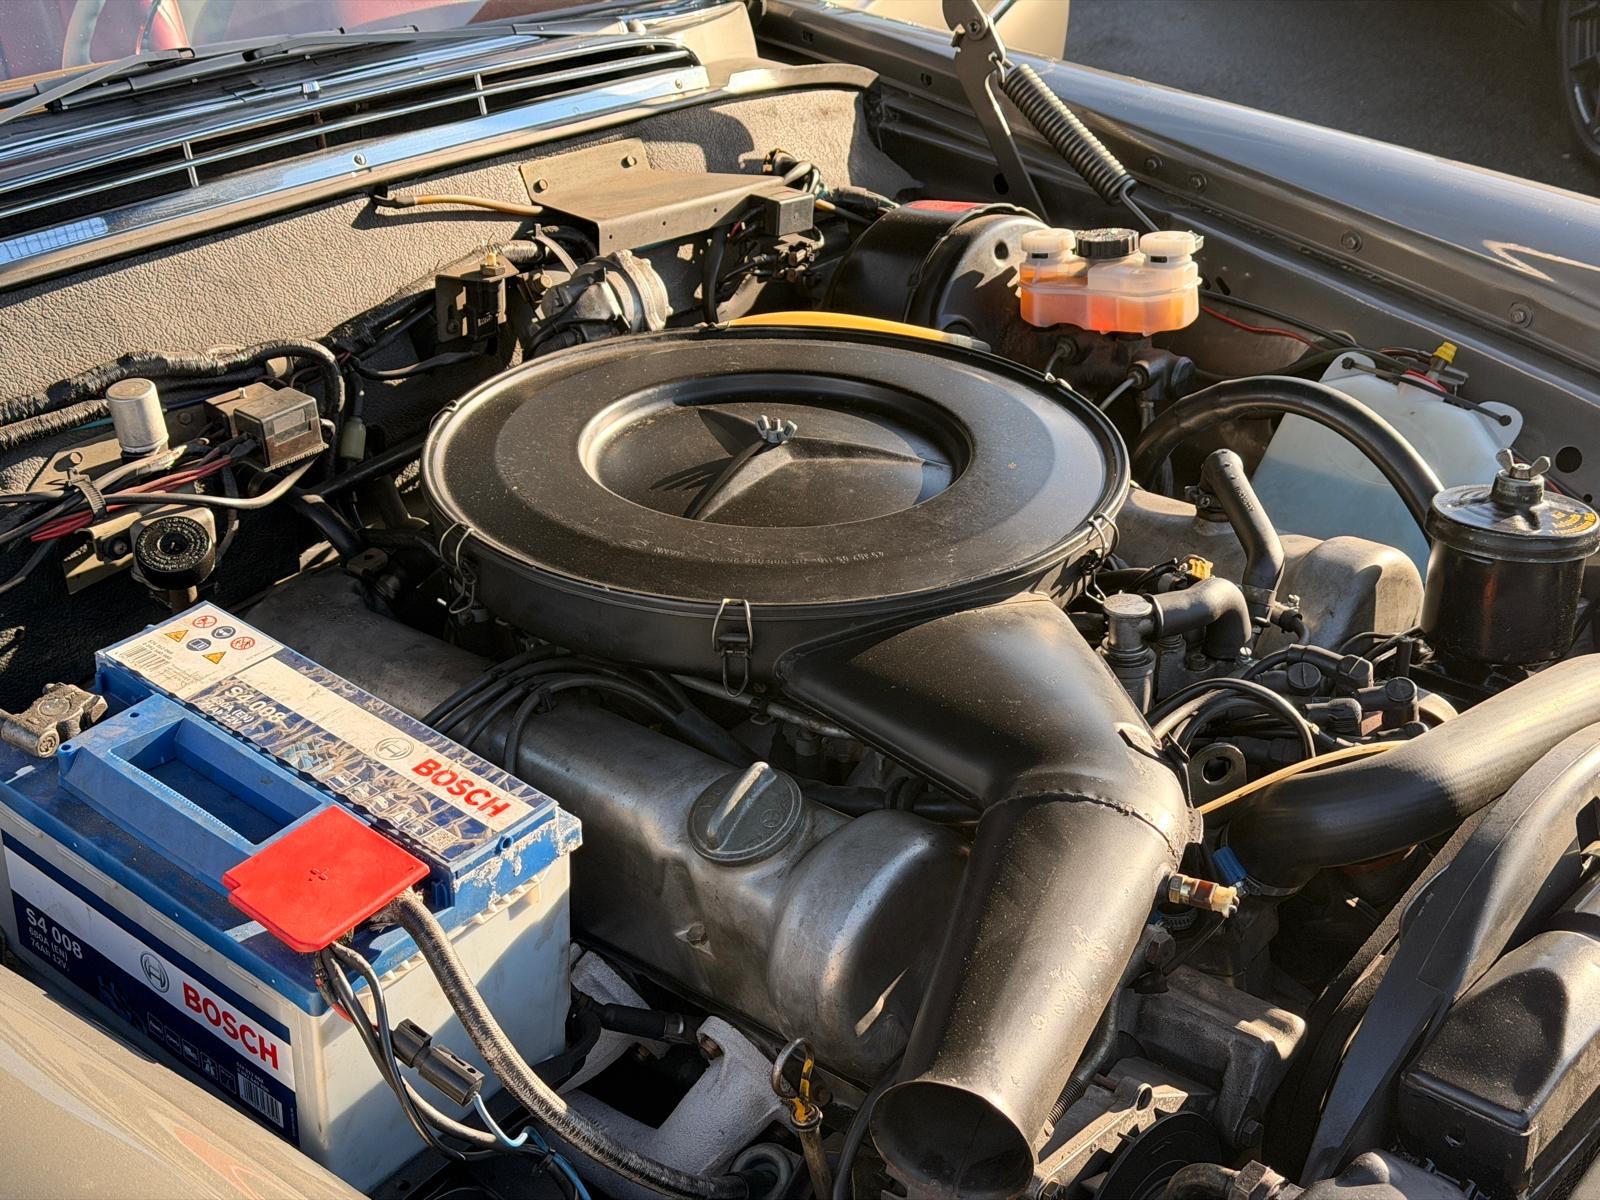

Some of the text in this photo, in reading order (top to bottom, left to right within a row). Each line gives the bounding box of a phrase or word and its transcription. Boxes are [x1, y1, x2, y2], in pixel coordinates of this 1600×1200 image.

[249, 700, 287, 723] 008
[411, 758, 511, 818] BOSCH
[26, 907, 83, 959] S4 008
[182, 980, 279, 1071] BOSCH
